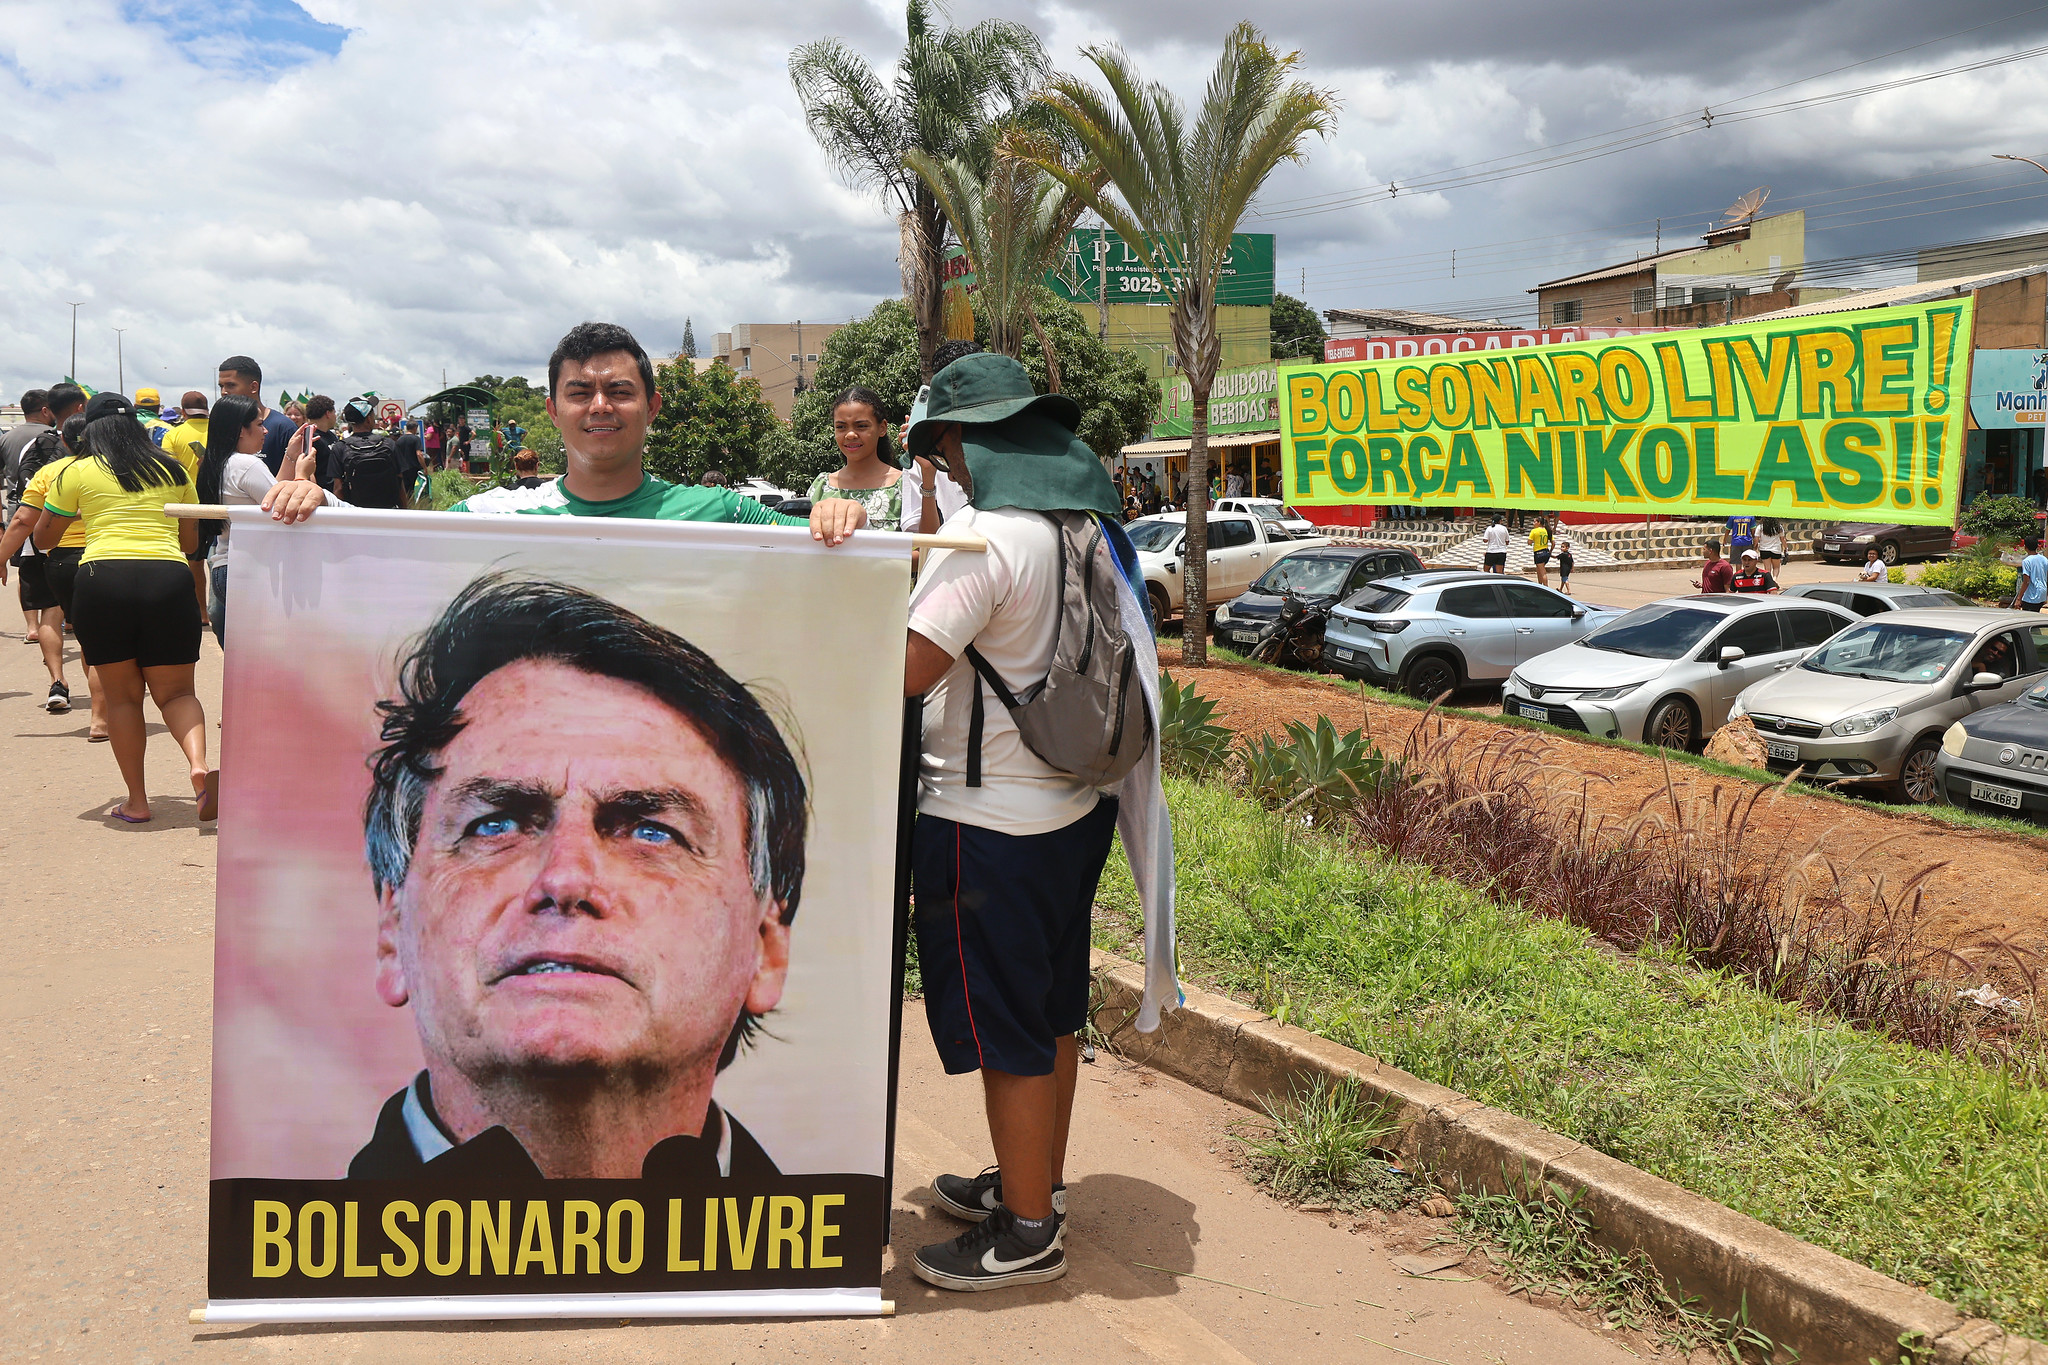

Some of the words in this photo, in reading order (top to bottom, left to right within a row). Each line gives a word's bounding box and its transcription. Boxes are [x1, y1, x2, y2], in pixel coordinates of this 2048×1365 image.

[1288, 346, 1654, 434] BOLSONARO
[1653, 306, 1963, 421] LIVRE!
[1211, 398, 1266, 426] BEBIDAS
[2027, 413, 2044, 421] PET
[1292, 426, 1495, 501] FORÇA
[1503, 417, 1949, 511] NIKOLAS!!
[1737, 523, 1748, 536] 10
[1774, 748, 1795, 760] 6465
[1973, 788, 2018, 807] JJK-4683
[252, 1198, 645, 1278] BOLSONARO
[667, 1194, 845, 1272] LIVRE
